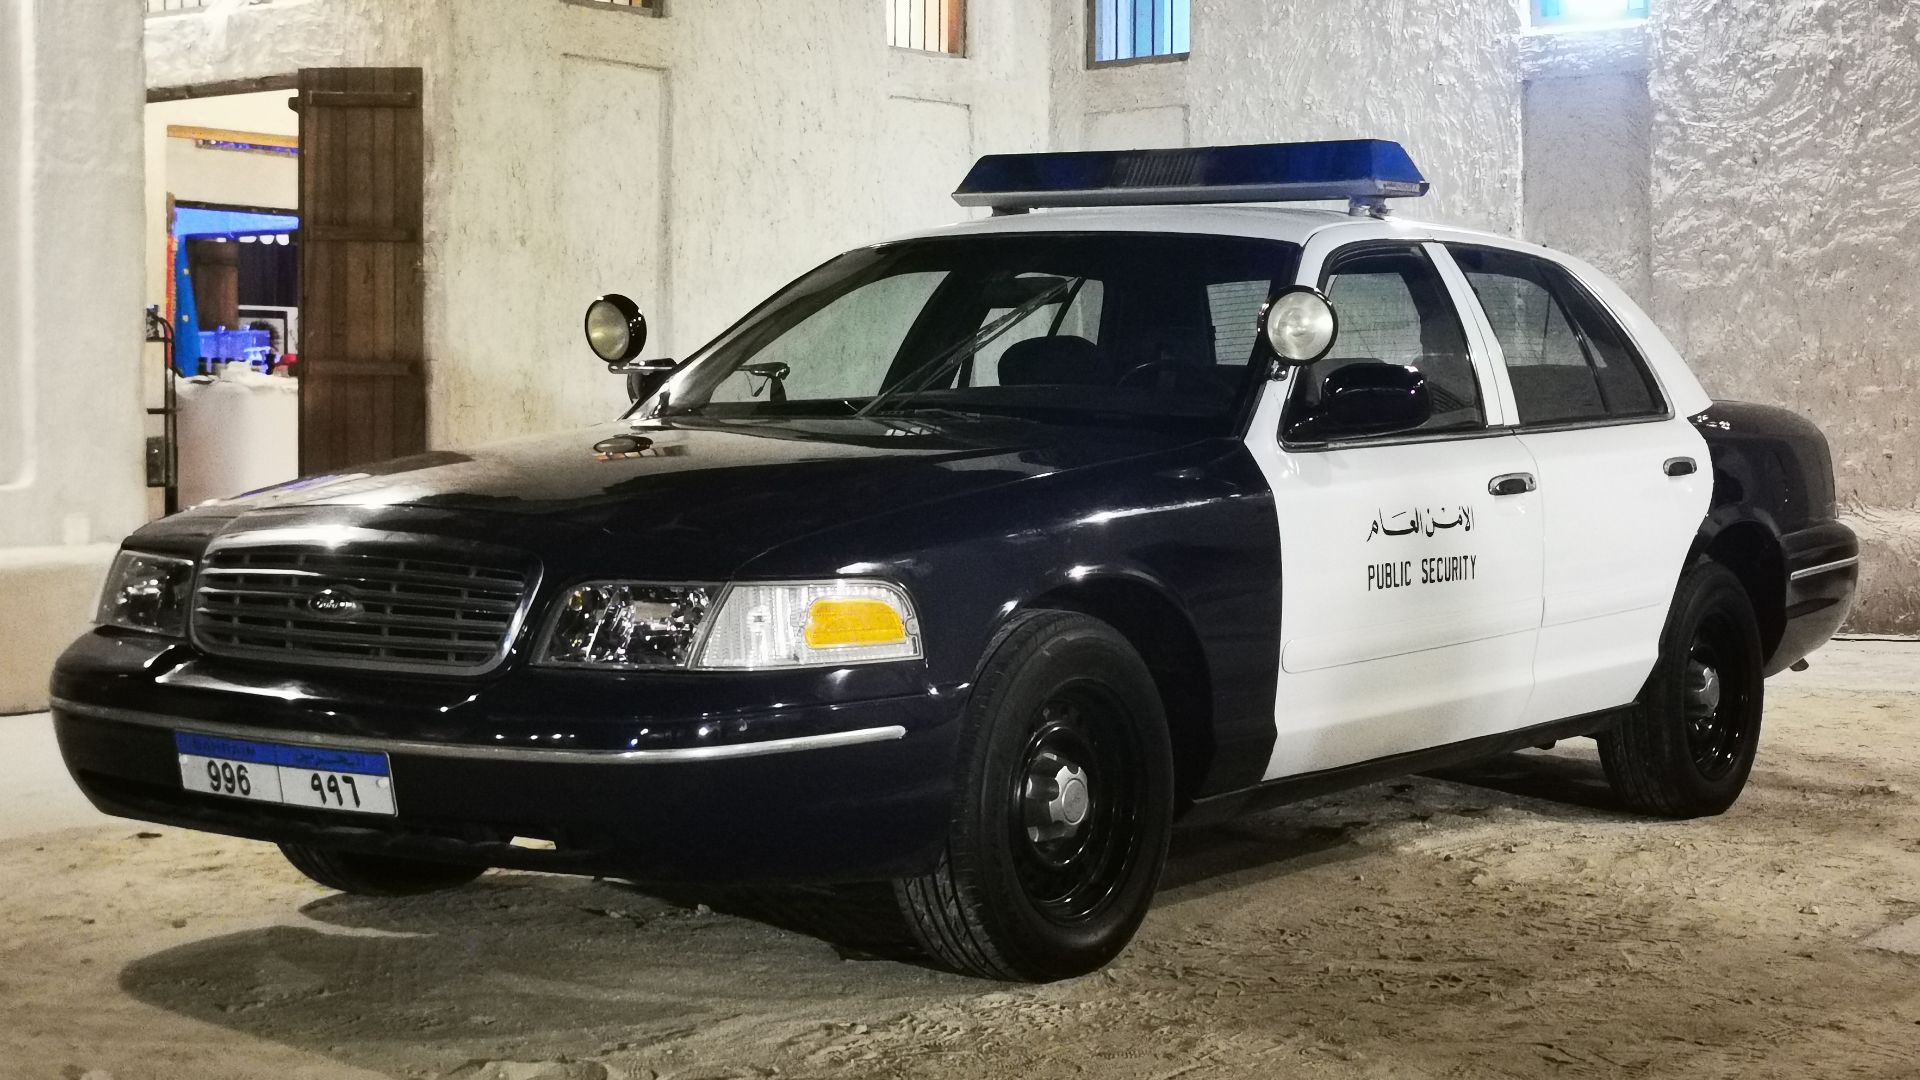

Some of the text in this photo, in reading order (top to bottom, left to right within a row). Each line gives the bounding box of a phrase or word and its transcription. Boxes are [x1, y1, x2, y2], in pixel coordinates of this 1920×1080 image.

[1367, 554, 1477, 591] PUBLIC SECURITY
[207, 760, 251, 796] 996
